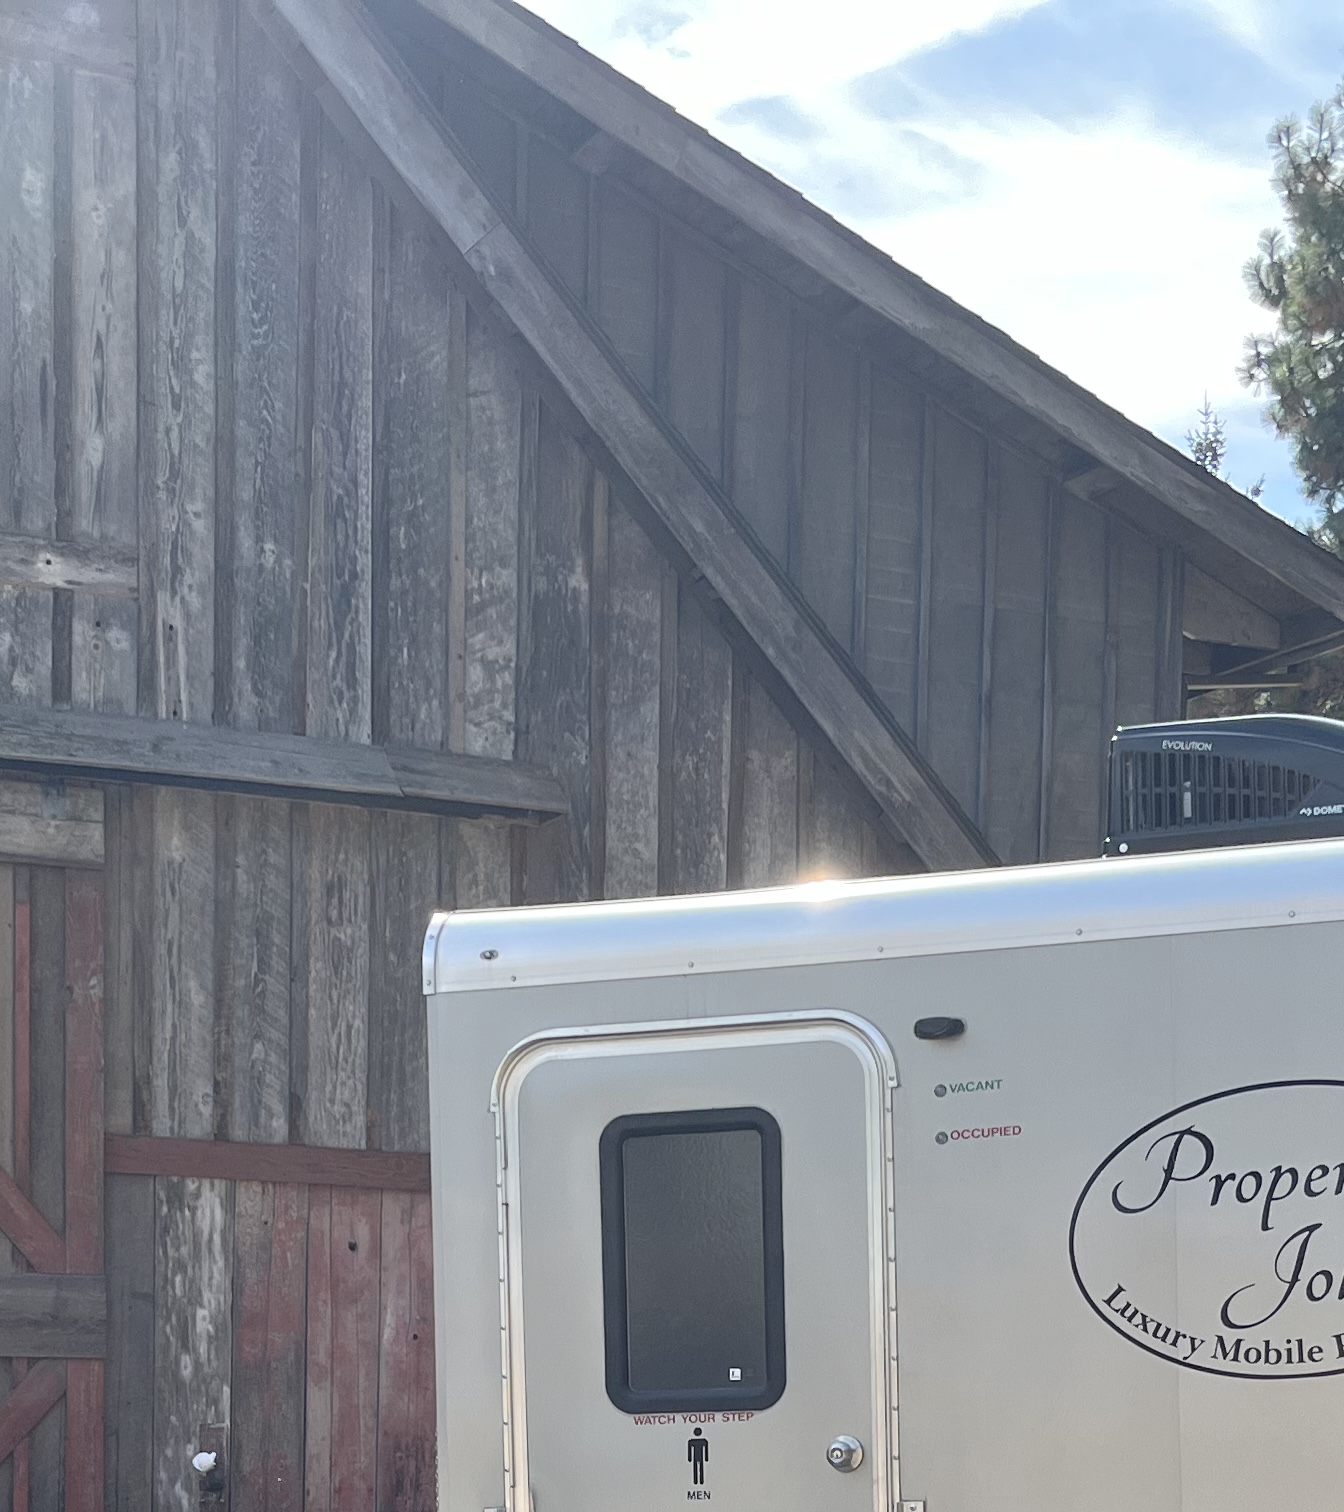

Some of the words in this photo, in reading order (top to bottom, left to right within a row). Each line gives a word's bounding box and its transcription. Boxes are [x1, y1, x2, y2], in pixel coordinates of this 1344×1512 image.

[1162, 739, 1213, 751] EVOLUTION
[949, 1079, 1003, 1093] VACANT
[950, 1125, 1022, 1141] OCCUPIED
[1102, 1283, 1206, 1361] Luxury
[1211, 1334, 1325, 1366] Mobile
[633, 1414, 676, 1426] WATCH
[681, 1413, 716, 1424] YOUR
[722, 1411, 755, 1423] STEP
[686, 1490, 711, 1500] MEN
